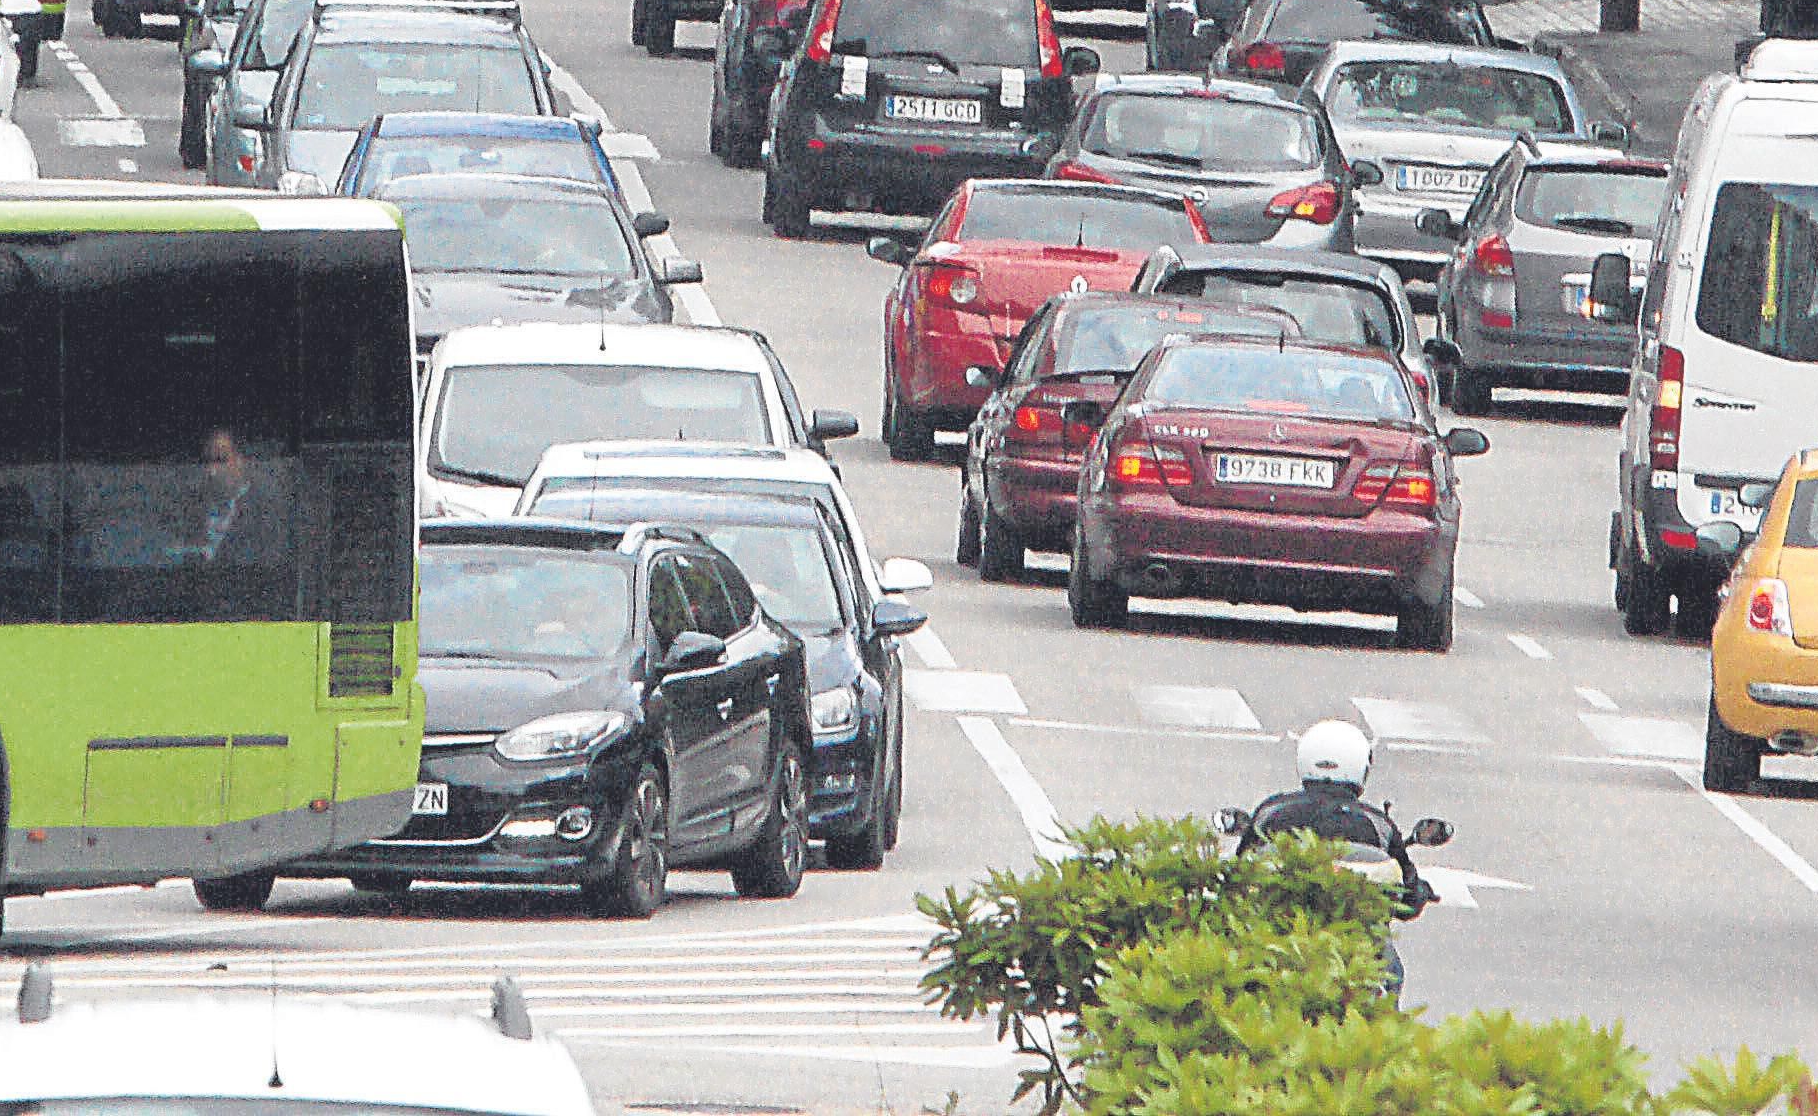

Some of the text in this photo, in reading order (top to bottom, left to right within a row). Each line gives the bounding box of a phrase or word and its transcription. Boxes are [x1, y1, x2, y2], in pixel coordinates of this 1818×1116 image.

[898, 99, 939, 115] 2511
[1231, 459, 1326, 483] 9738 FKK
